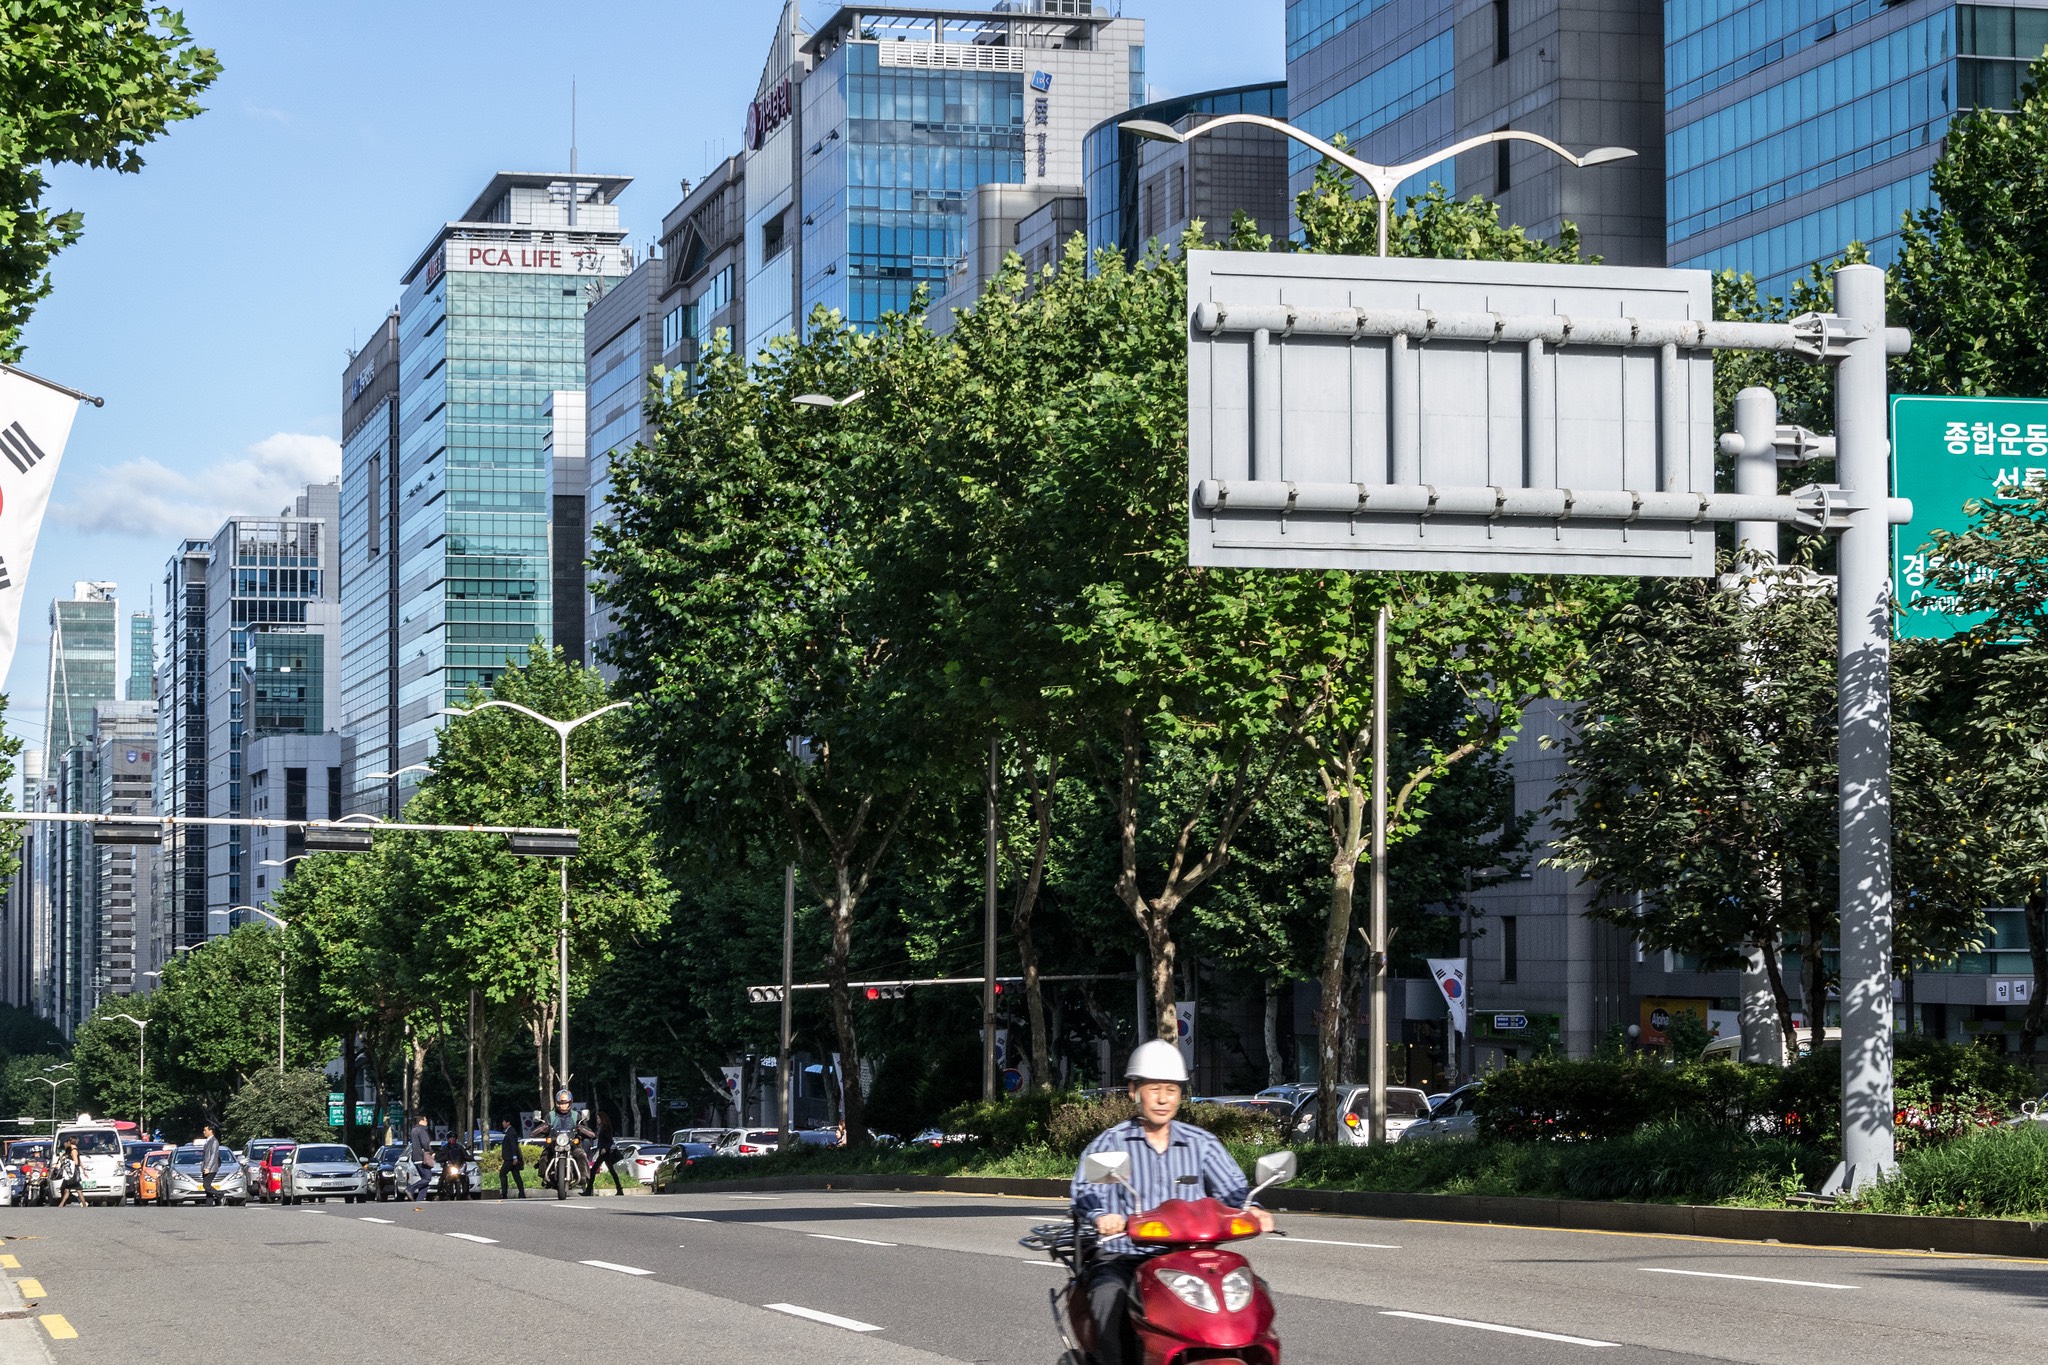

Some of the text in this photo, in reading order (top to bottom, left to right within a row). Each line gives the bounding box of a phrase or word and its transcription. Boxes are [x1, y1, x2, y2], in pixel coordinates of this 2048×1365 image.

[758, 79, 789, 132] 가연타워
[1035, 97, 1048, 126] IBK
[469, 248, 562, 268] PCA LIFE
[1943, 421, 2048, 457] 종합운동
[1651, 1012, 1670, 1028] Alpha
